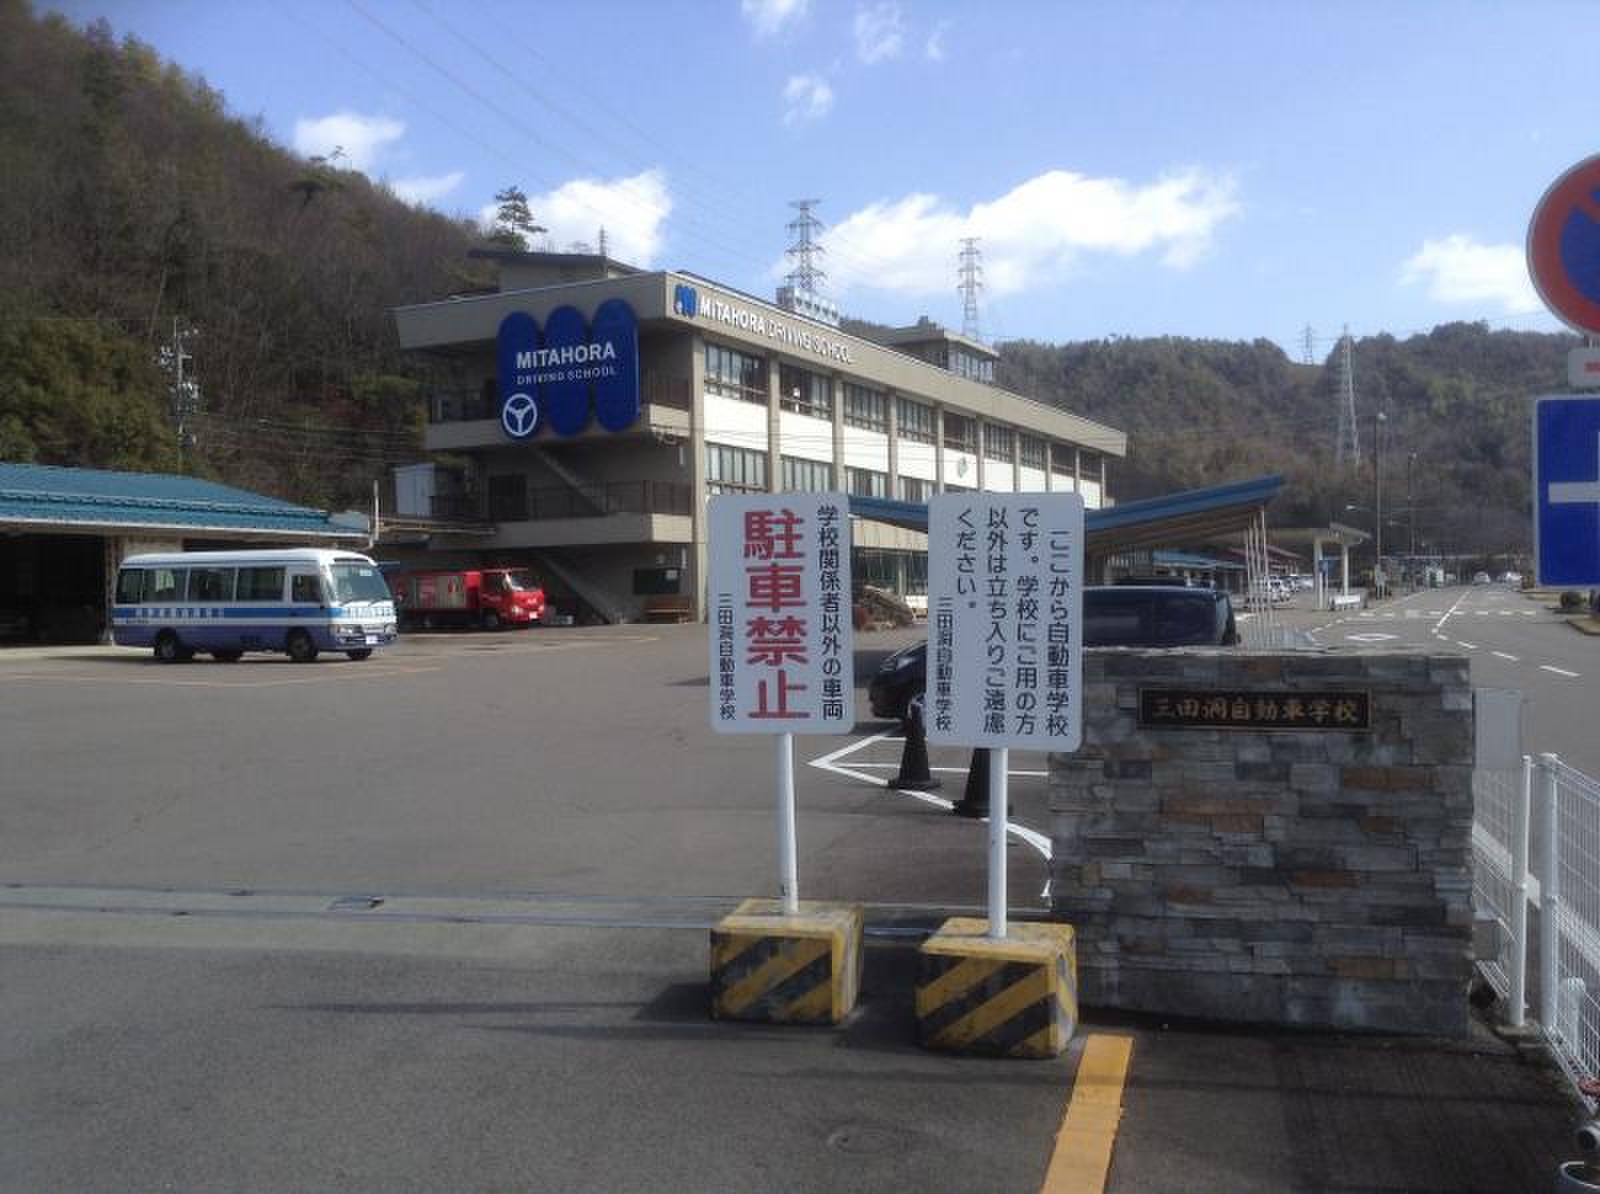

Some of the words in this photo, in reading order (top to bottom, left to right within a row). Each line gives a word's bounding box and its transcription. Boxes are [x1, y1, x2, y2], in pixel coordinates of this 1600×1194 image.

[516, 342, 616, 369] MITAHORA
[699, 295, 766, 334] MITAHORA
[517, 372, 565, 385] DRIVING
[566, 367, 617, 382] SCHOOL
[956, 508, 977, 609] ください。
[743, 508, 810, 720] 駐車禁止
[816, 505, 843, 721] 学校関係者以外の車両
[1045, 530, 1070, 737] ここから自動車学校
